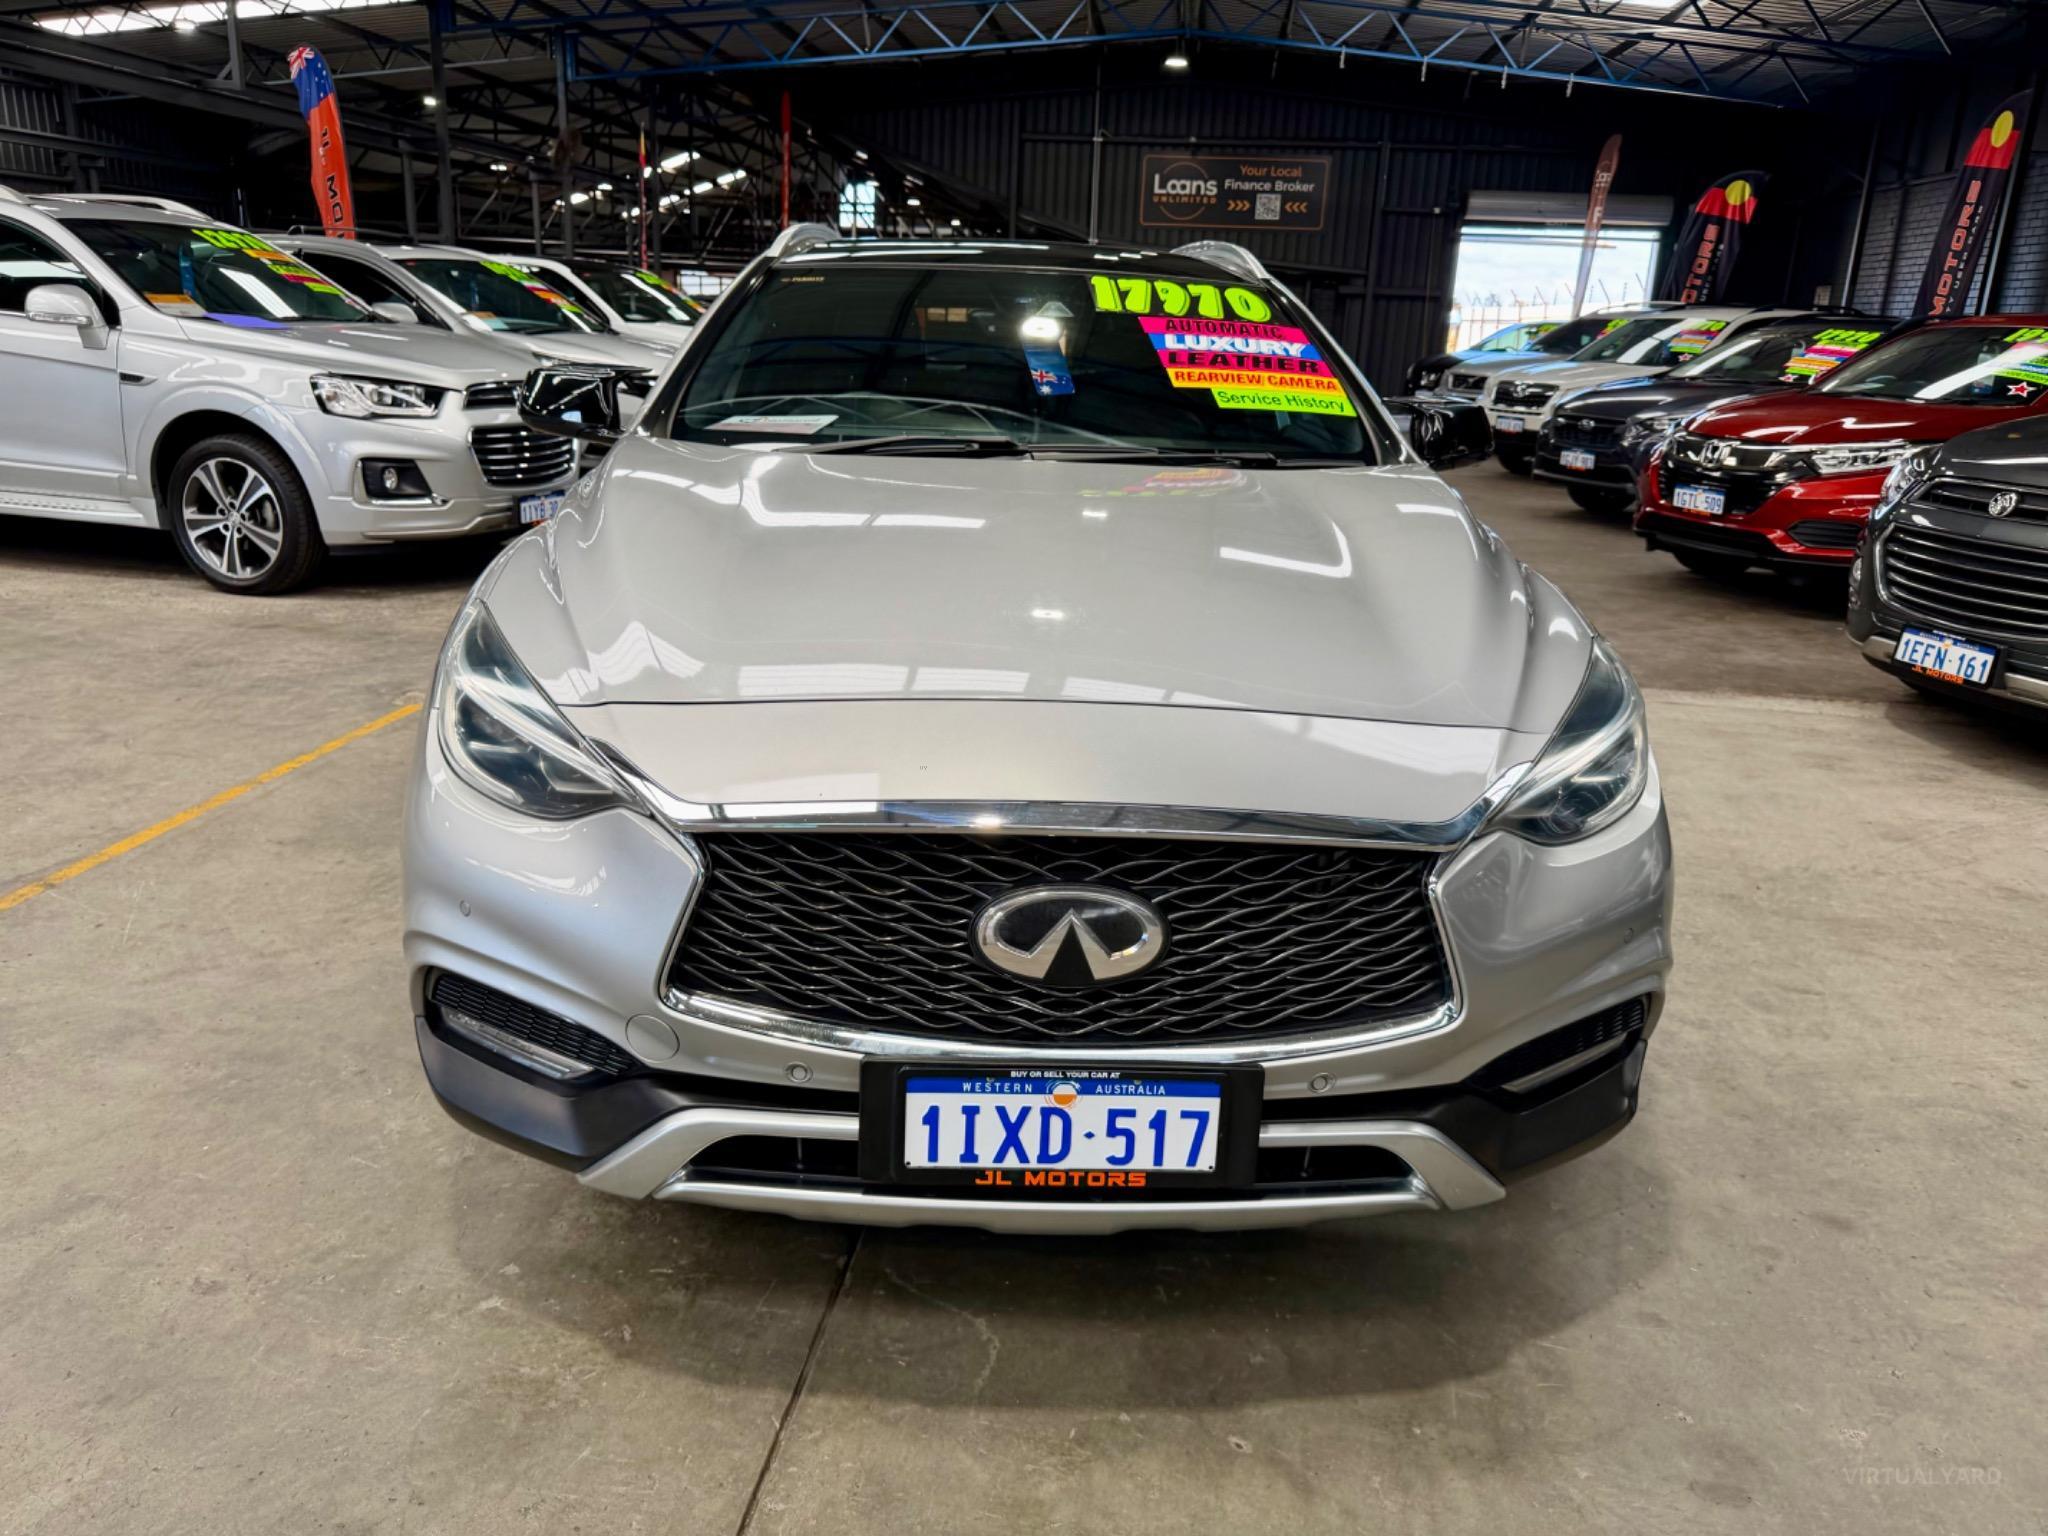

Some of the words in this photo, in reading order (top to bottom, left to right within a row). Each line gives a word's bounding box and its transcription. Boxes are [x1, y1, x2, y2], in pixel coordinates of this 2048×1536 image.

[1240, 164, 1267, 176] Your
[1270, 166, 1302, 177] Local
[1153, 173, 1218, 195] Loans
[1224, 179, 1271, 191] Finance
[1275, 181, 1315, 193] Broker
[326, 173, 345, 239] MO
[1153, 195, 1217, 204] UNLIMITED
[1928, 180, 1982, 316] MOTORS
[1680, 224, 1720, 304] OTORS
[1091, 275, 1272, 322] 17970
[1164, 319, 1284, 339] AUTOMATIC
[1164, 334, 1307, 357] LUXURY
[1167, 351, 1320, 373] LEATHER
[1174, 370, 1263, 386] REARVIEW
[1267, 375, 1338, 391] CAMERA
[1217, 390, 1282, 406] Service
[1286, 393, 1346, 413] History
[1926, 668, 1965, 685] MOTORS
[1010, 1070, 1028, 1078] BUY
[962, 1082, 1032, 1094] WESTERN
[1095, 1083, 1166, 1096] AUSTRALIA
[975, 1171, 1011, 1186] JL
[1025, 1171, 1147, 1187] MOTORS
